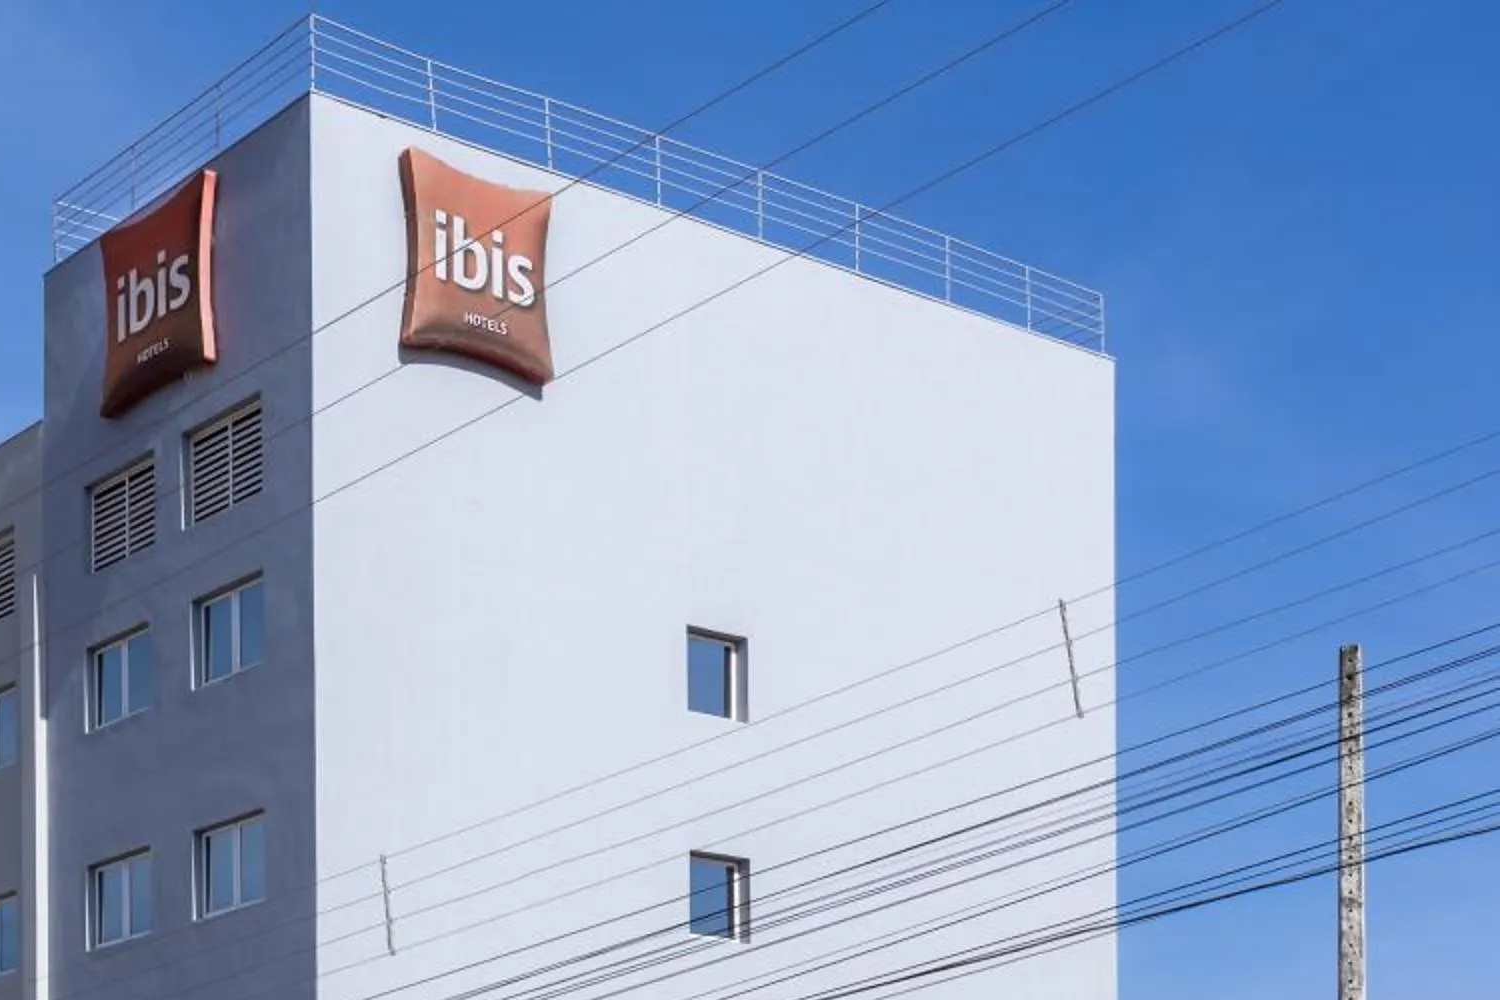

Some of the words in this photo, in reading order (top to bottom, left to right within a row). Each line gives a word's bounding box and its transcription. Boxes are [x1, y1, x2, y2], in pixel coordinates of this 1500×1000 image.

[117, 250, 191, 343] ibis
[435, 208, 536, 307] ibis
[463, 311, 508, 335] HOTELS
